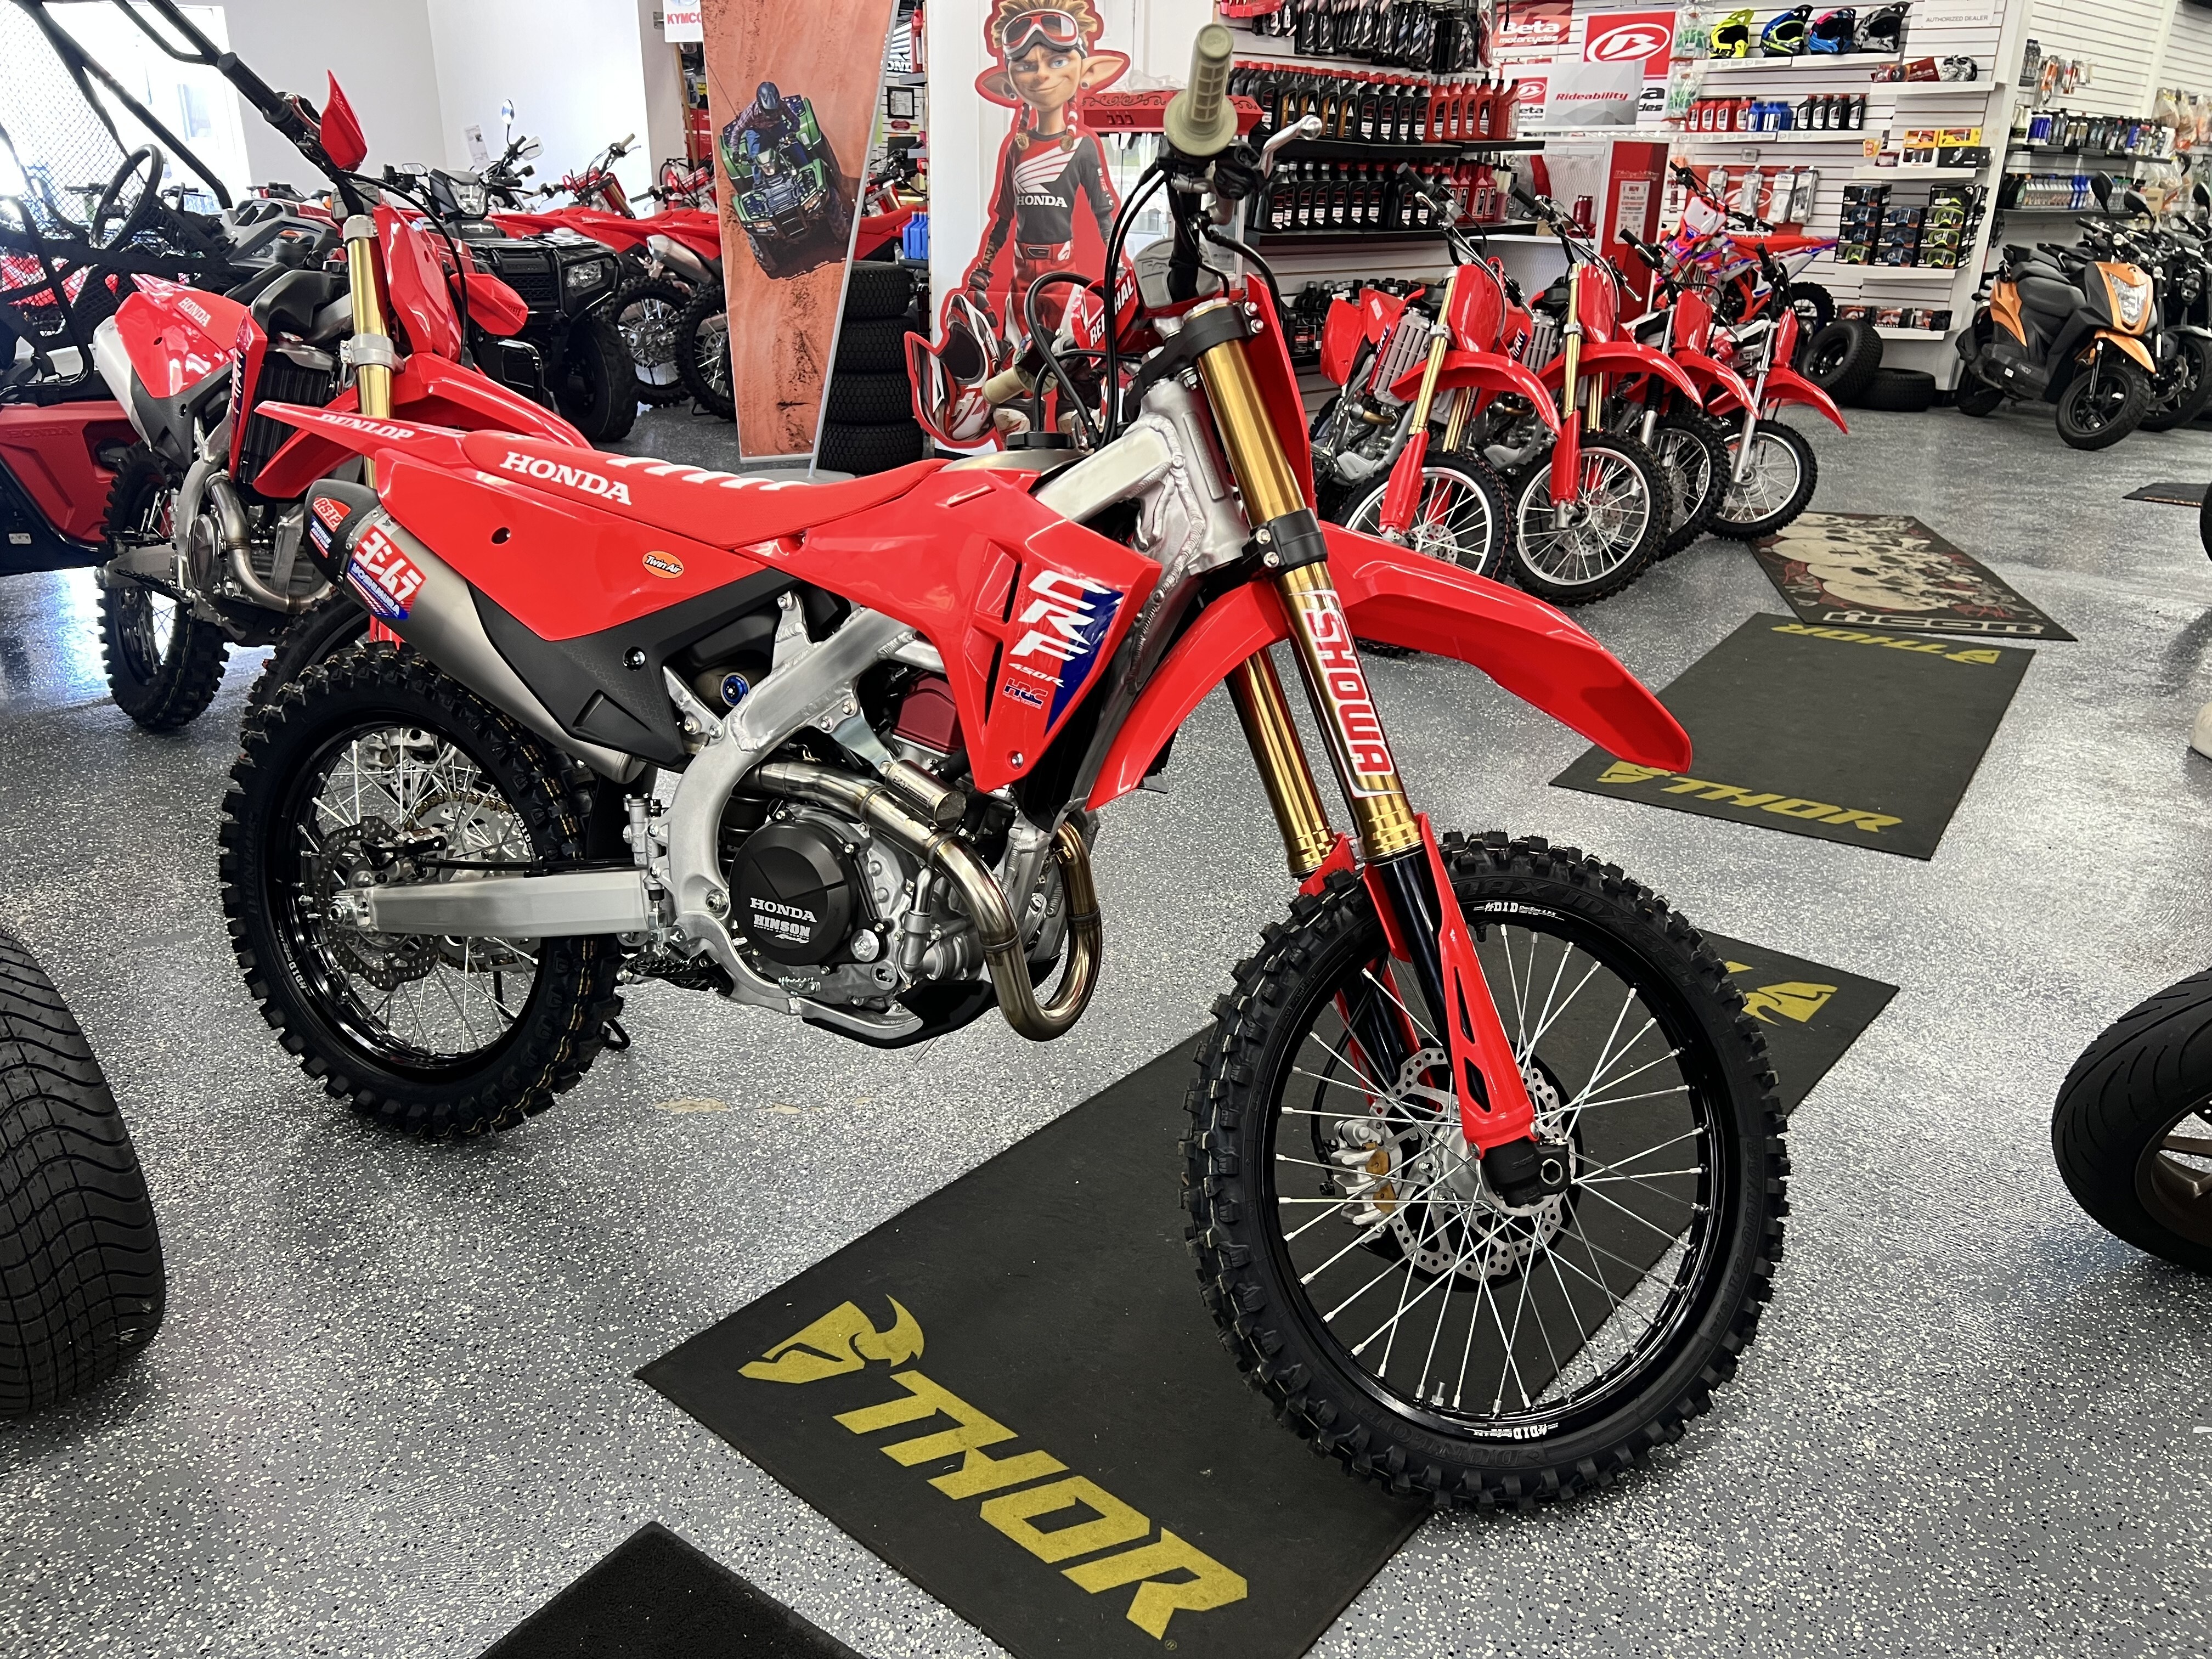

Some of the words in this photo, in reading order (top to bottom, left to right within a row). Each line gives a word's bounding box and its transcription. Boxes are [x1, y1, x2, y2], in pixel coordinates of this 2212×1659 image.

[1498, 35, 1559, 44] motorcycles
[1499, 20, 1560, 35] Beta
[1555, 92, 1628, 101] Rideability
[1017, 195, 1068, 207] HONDA
[177, 296, 211, 328] HONDA
[316, 413, 415, 440] DUNLOP
[500, 451, 631, 506] HONDA
[645, 555, 668, 569] Twin
[665, 563, 682, 574] Air
[351, 562, 400, 616] YOSHIMURA
[1009, 569, 1111, 662] CRF
[1771, 623, 1948, 654] THOR
[1008, 663, 1065, 688] 450R
[1003, 677, 1049, 707] HRC
[1302, 607, 1394, 776] SHOWA
[1660, 777, 1903, 833] THOR
[749, 898, 817, 923] HONDA
[754, 914, 811, 937] HINSON
[832, 1369, 1248, 1640] THOR
